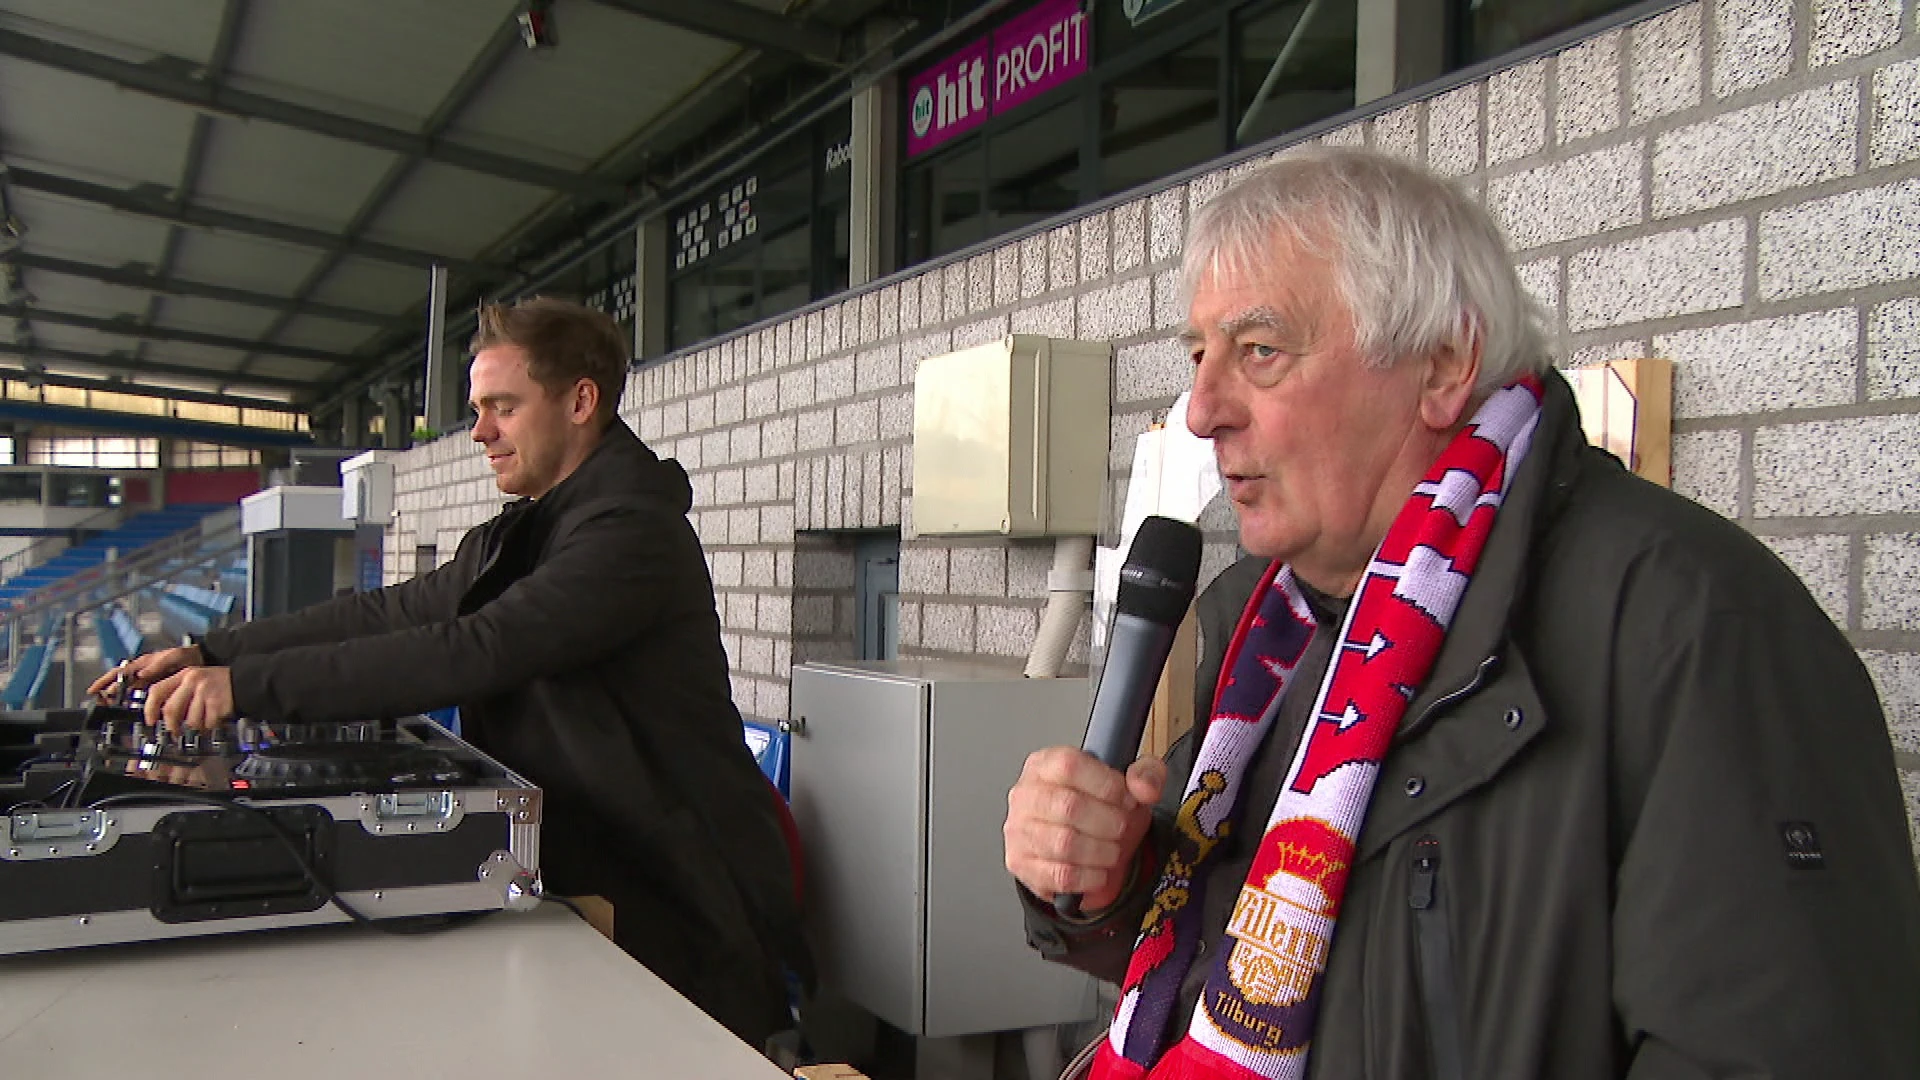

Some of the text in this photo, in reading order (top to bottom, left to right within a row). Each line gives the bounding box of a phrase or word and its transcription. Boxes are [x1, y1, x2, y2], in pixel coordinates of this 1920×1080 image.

[937, 12, 1087, 130] hit PROFIT
[826, 138, 852, 172] Rabo
[1215, 991, 1283, 1046] Tilburg
